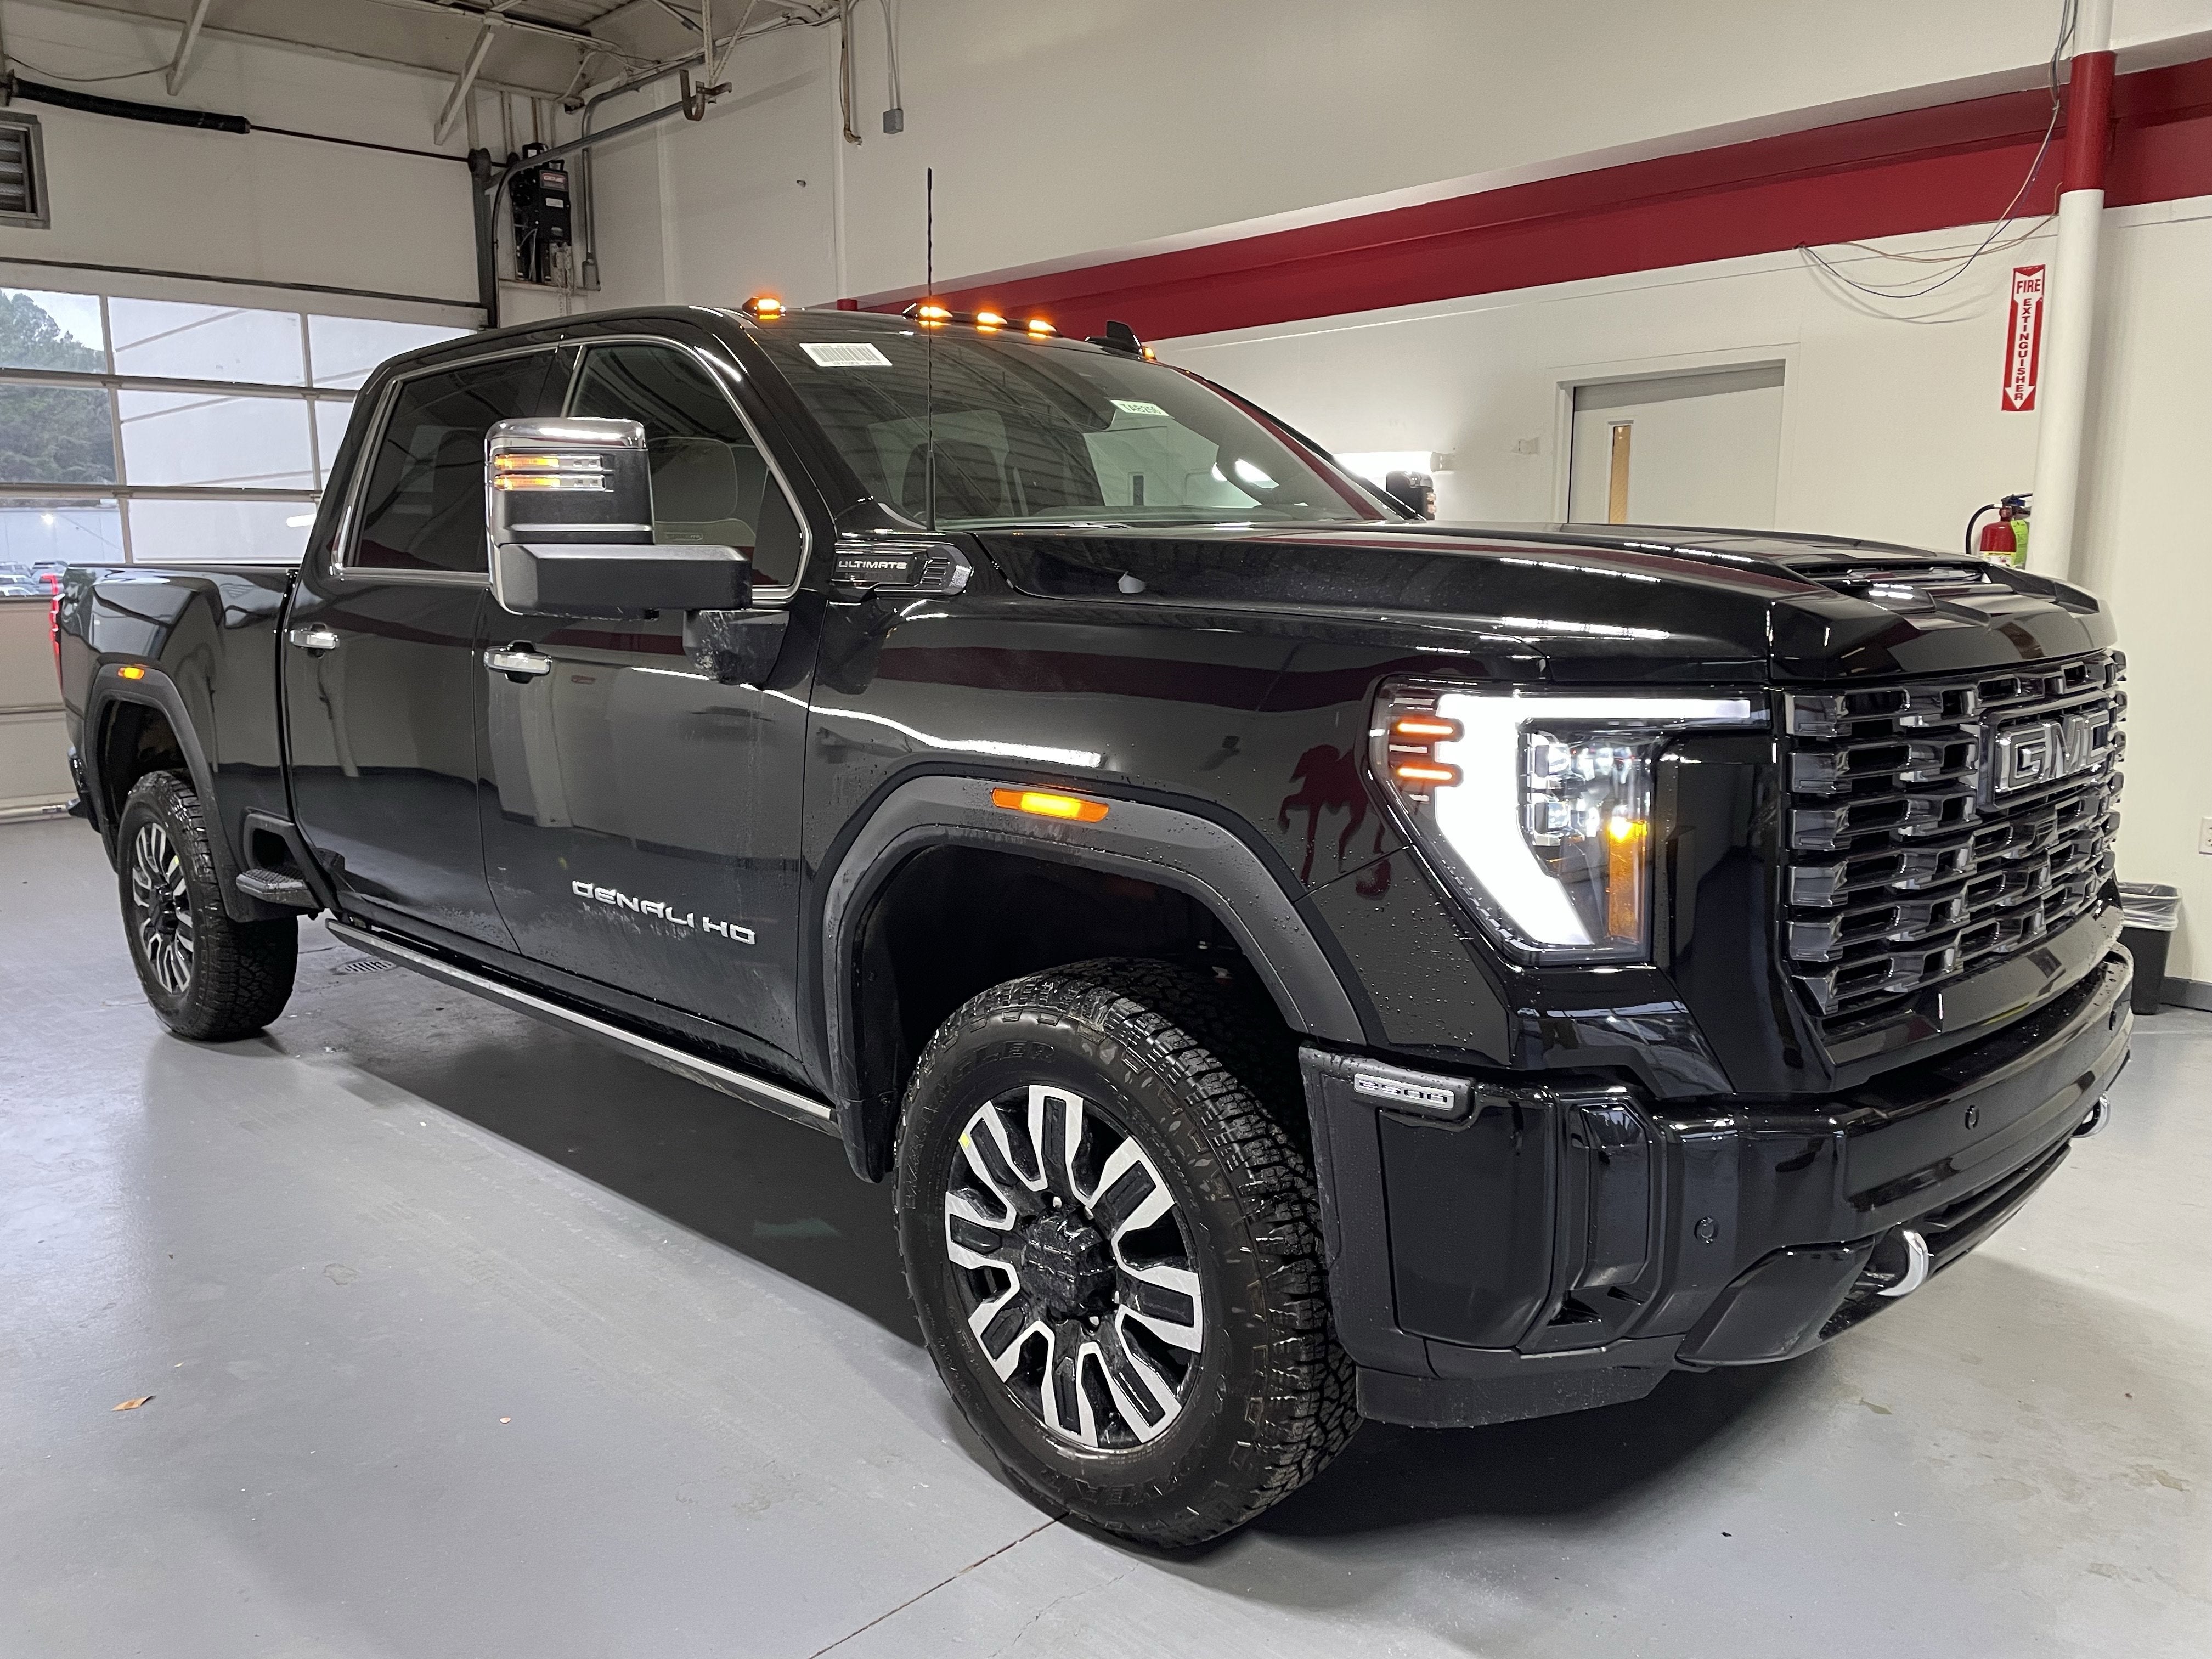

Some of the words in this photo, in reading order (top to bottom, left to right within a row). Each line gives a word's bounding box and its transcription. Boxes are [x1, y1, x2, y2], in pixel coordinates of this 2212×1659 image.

[2016, 278, 2041, 294] FIRE
[2014, 298, 2032, 401] EXTINGUISHER
[838, 560, 907, 570] ULTIMATE
[1997, 709, 2110, 791] GMC
[572, 880, 695, 928] DENALI
[702, 916, 755, 945] HD
[1358, 1080, 1448, 1105] 2500
